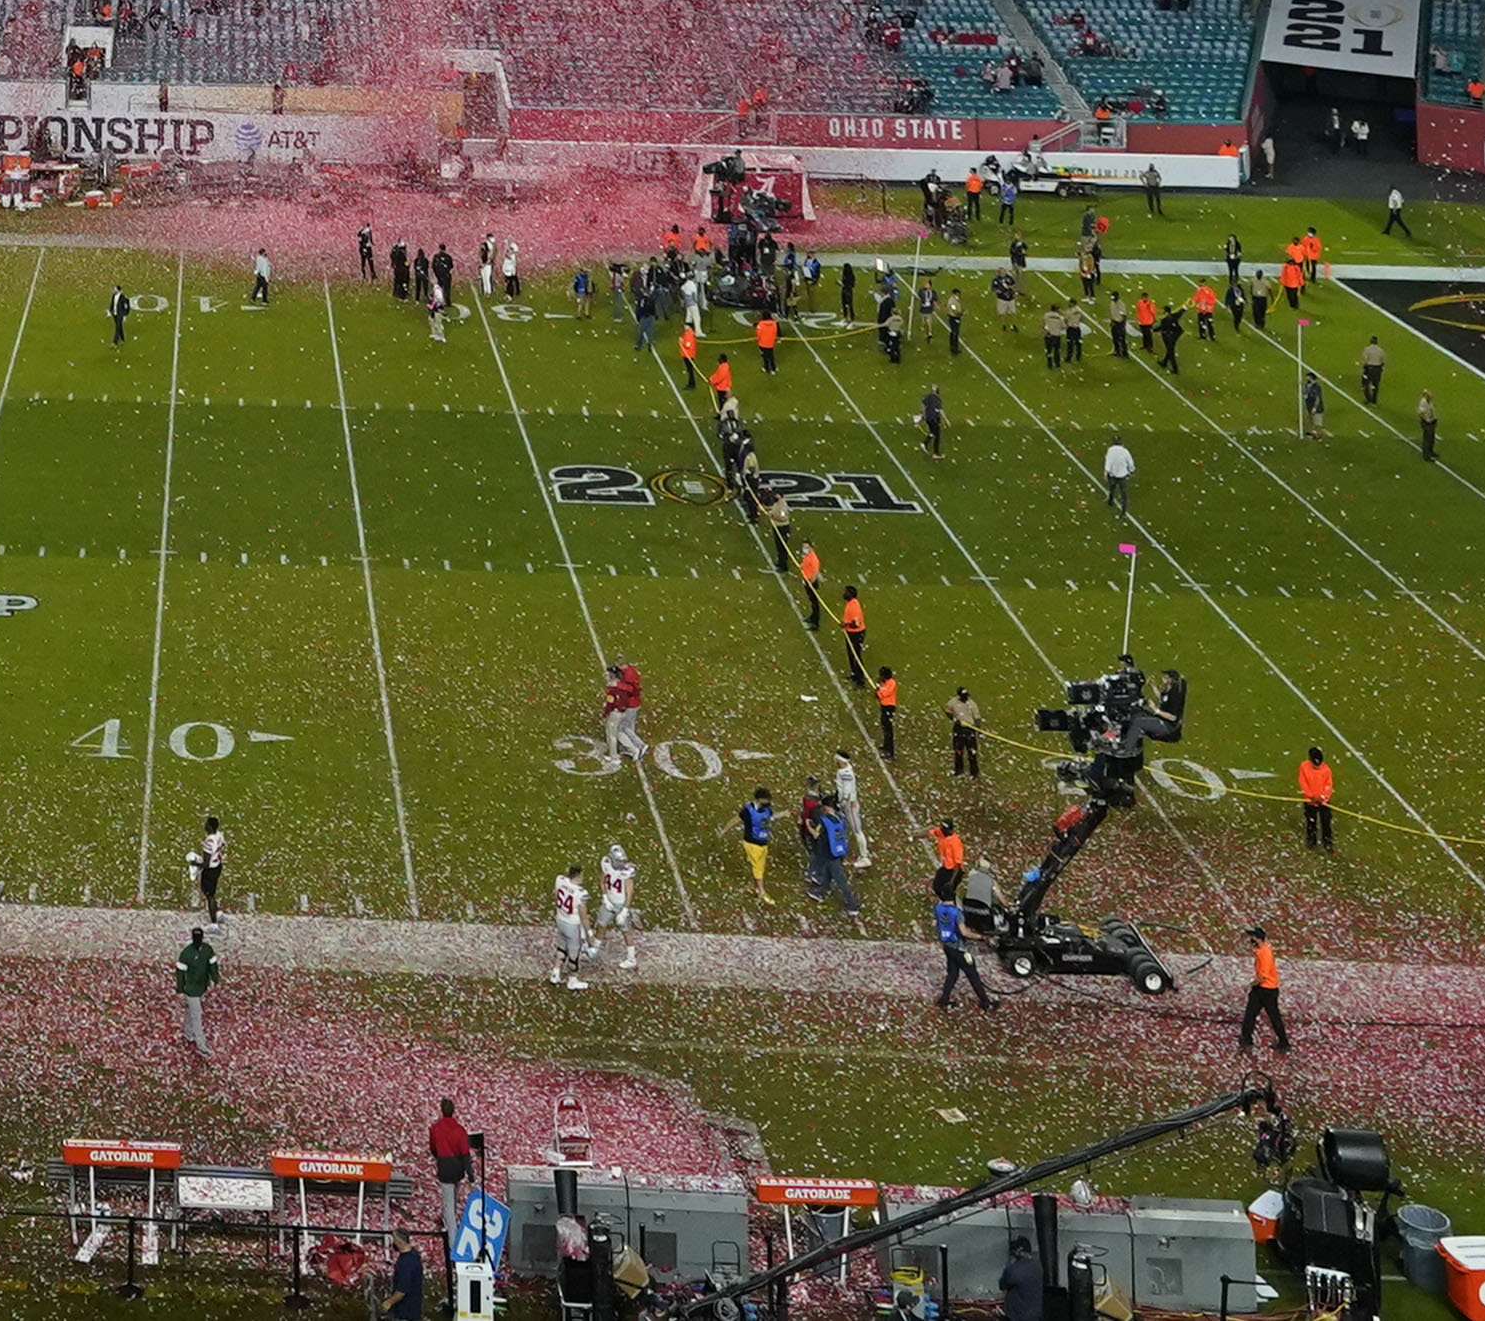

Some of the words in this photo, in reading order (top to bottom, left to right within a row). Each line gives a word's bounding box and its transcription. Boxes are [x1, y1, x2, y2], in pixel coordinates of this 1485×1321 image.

[828, 117, 886, 140] OHIO
[893, 118, 963, 141] STATE
[267, 131, 321, 150] AT&T
[70, 718, 235, 761] 40
[550, 735, 723, 782] 30
[89, 1149, 155, 1164] GATORADE
[298, 1160, 364, 1176] GATORADE
[784, 1186, 851, 1201] GATORADE
